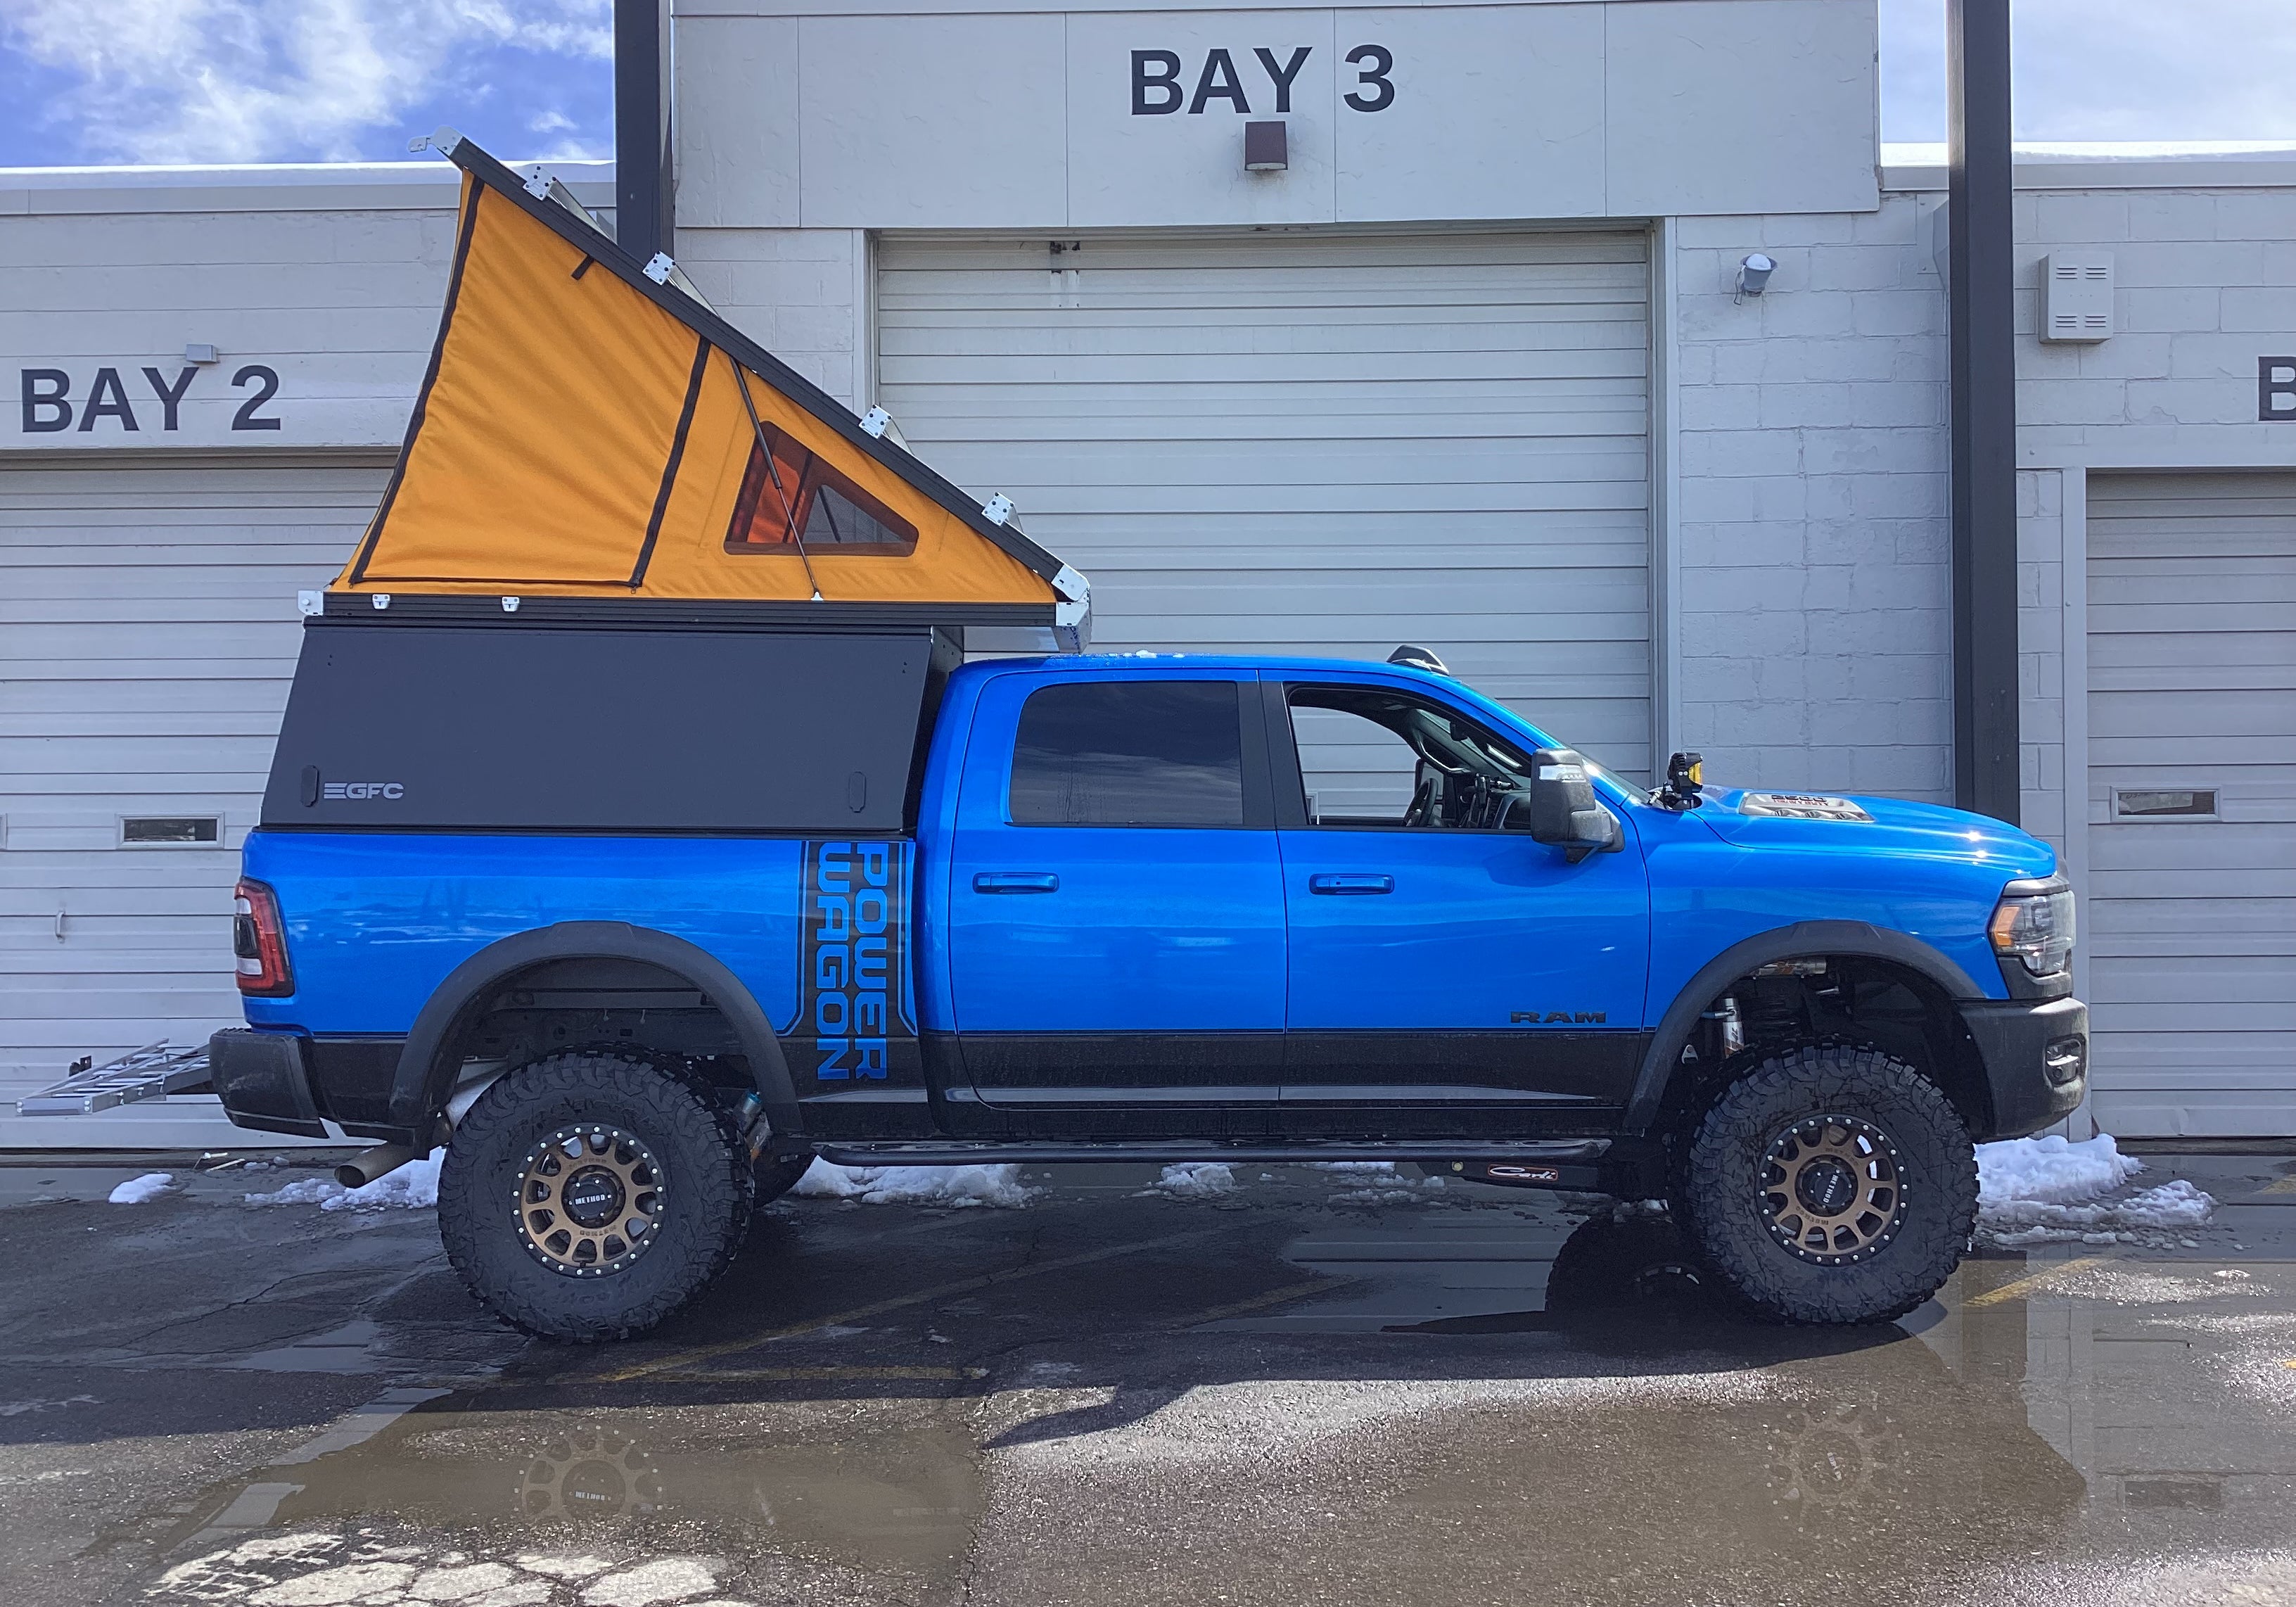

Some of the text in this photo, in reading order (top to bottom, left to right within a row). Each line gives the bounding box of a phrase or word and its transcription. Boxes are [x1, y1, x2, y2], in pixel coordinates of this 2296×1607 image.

[1131, 44, 1395, 115] BAY 3
[21, 365, 281, 432] BAY 2
[2258, 356, 2296, 421] B
[816, 842, 851, 1080] WAGON
[855, 843, 889, 1079] POWER
[1510, 1011, 1606, 1023] RAM
[575, 1194, 606, 1205] METHOD
[1823, 1174, 1839, 1203] METHOD
